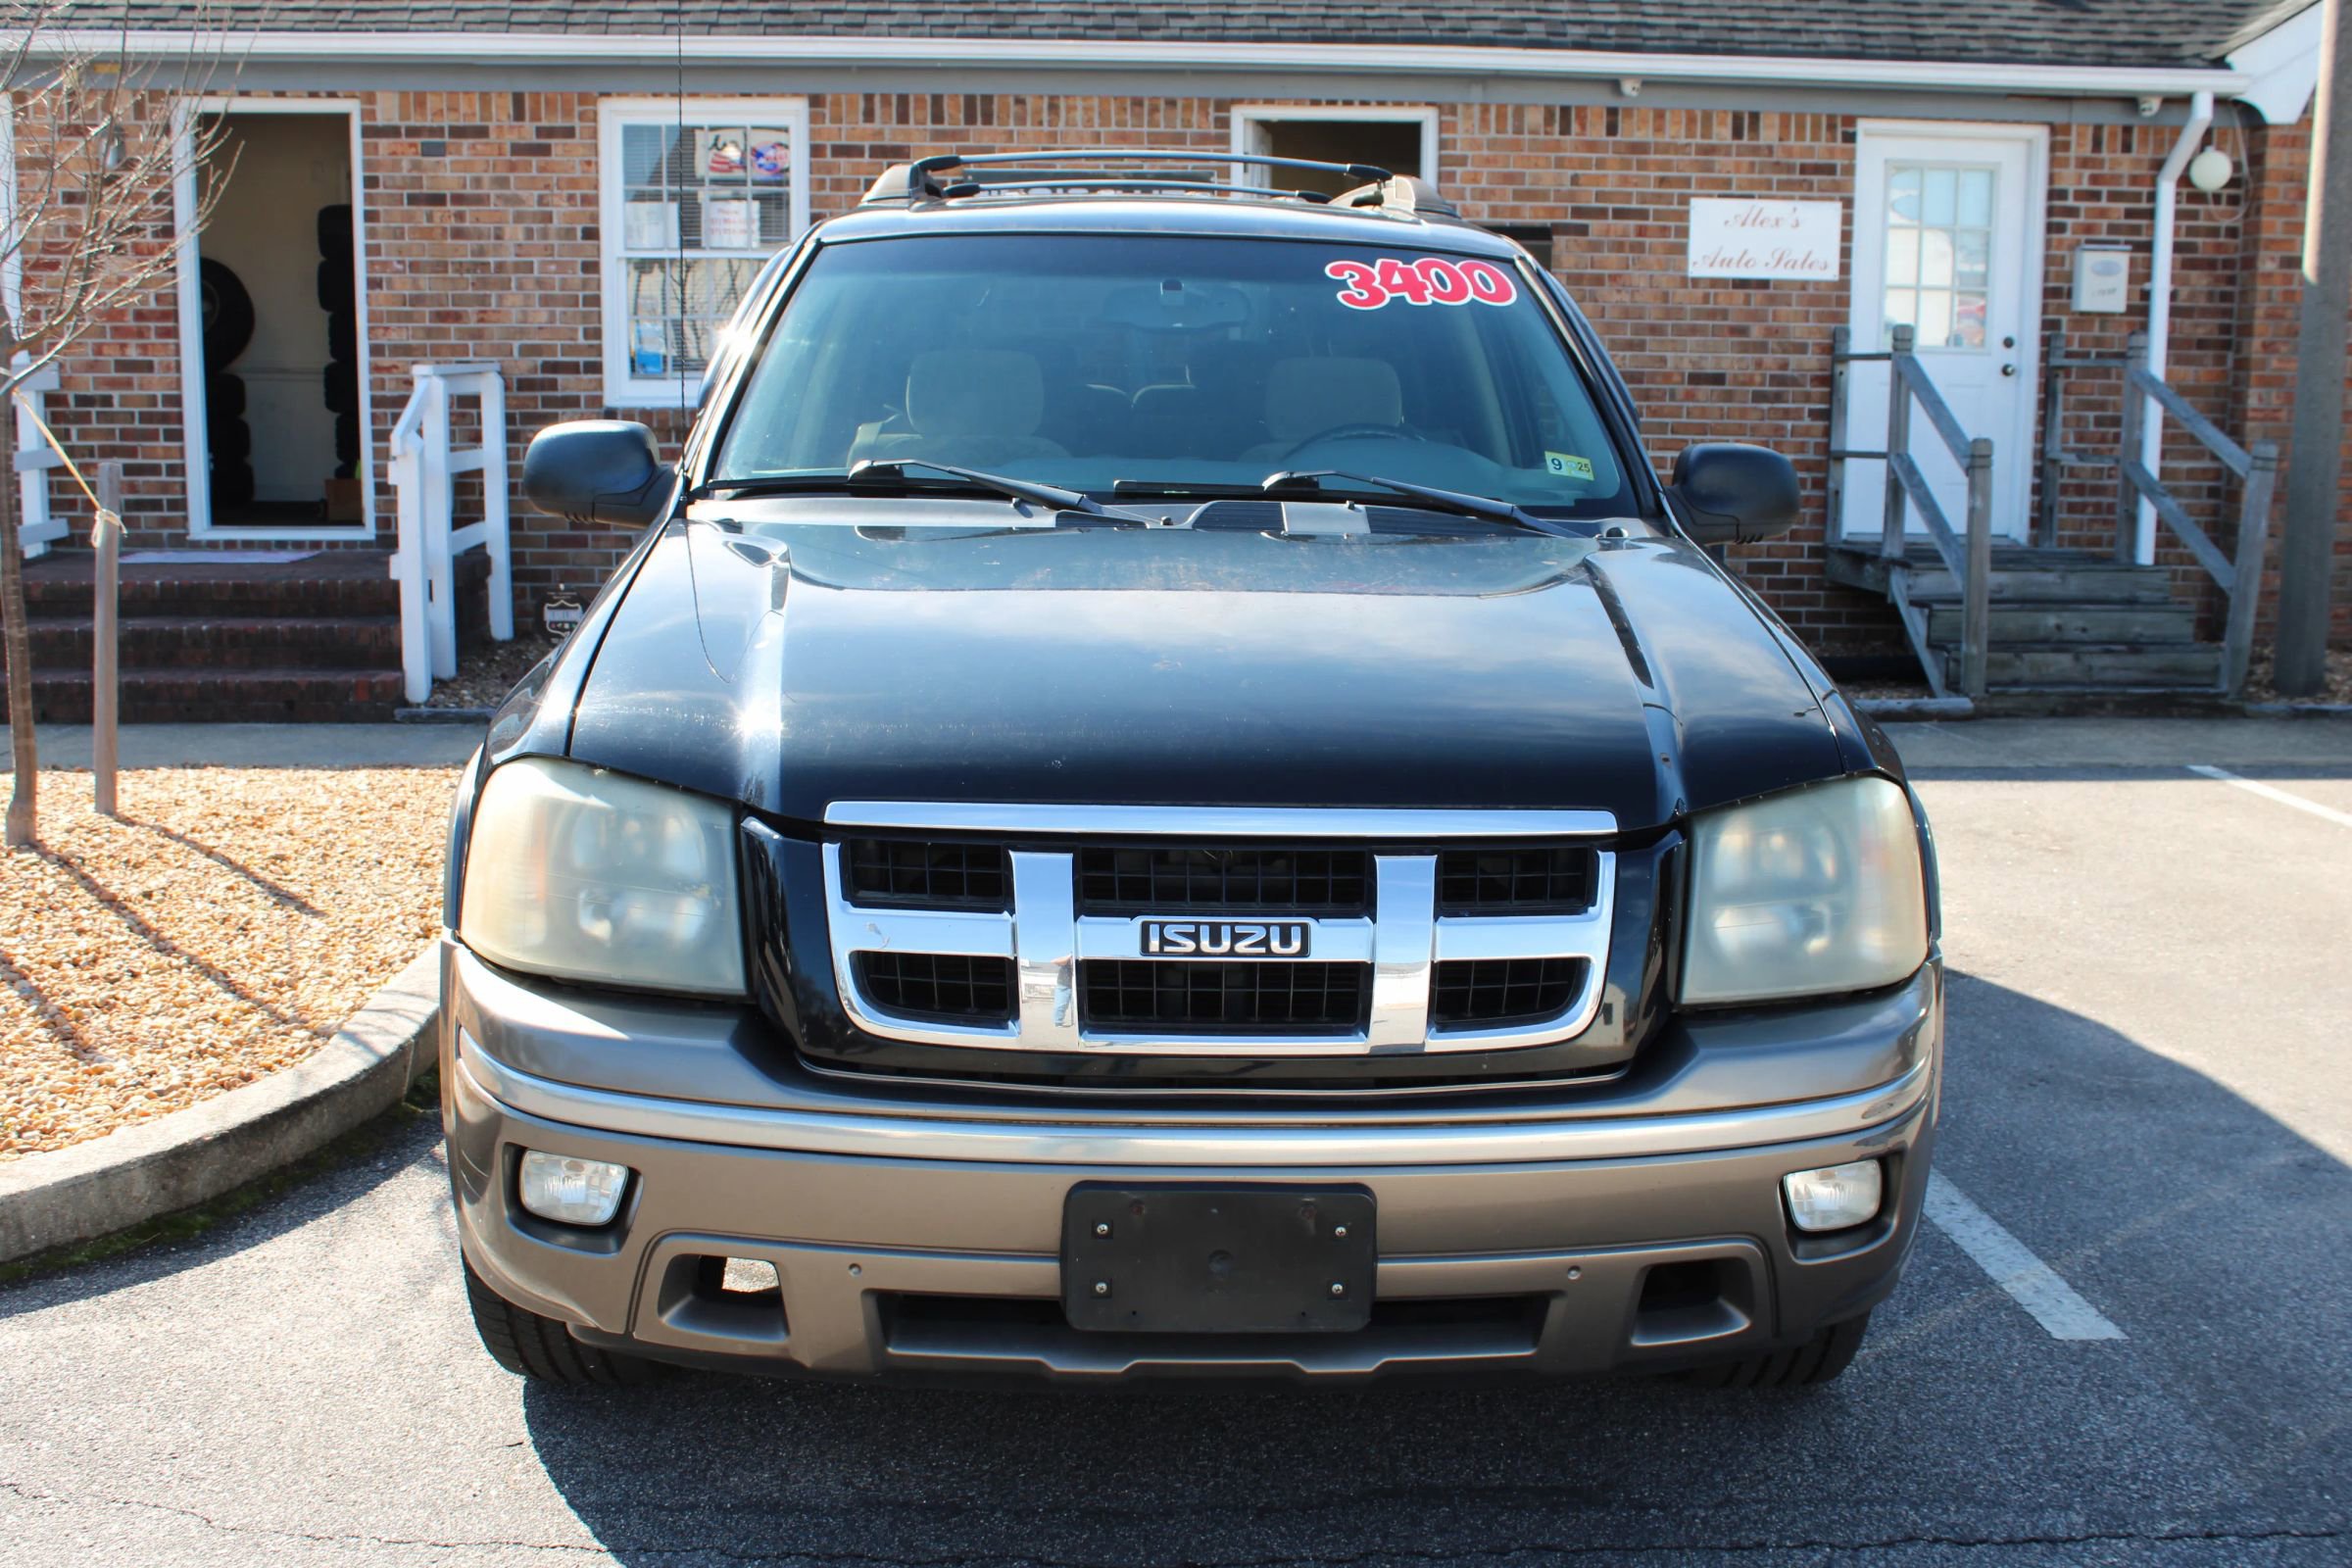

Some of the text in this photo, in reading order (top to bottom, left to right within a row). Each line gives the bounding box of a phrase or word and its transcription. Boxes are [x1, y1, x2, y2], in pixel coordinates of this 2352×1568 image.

[1724, 204, 1802, 228] Alex's
[1692, 245, 1830, 271] Auto Sales
[1324, 258, 1517, 310] 3400
[1550, 458, 1591, 472] 9 25
[1149, 923, 1301, 955] ISUZU
